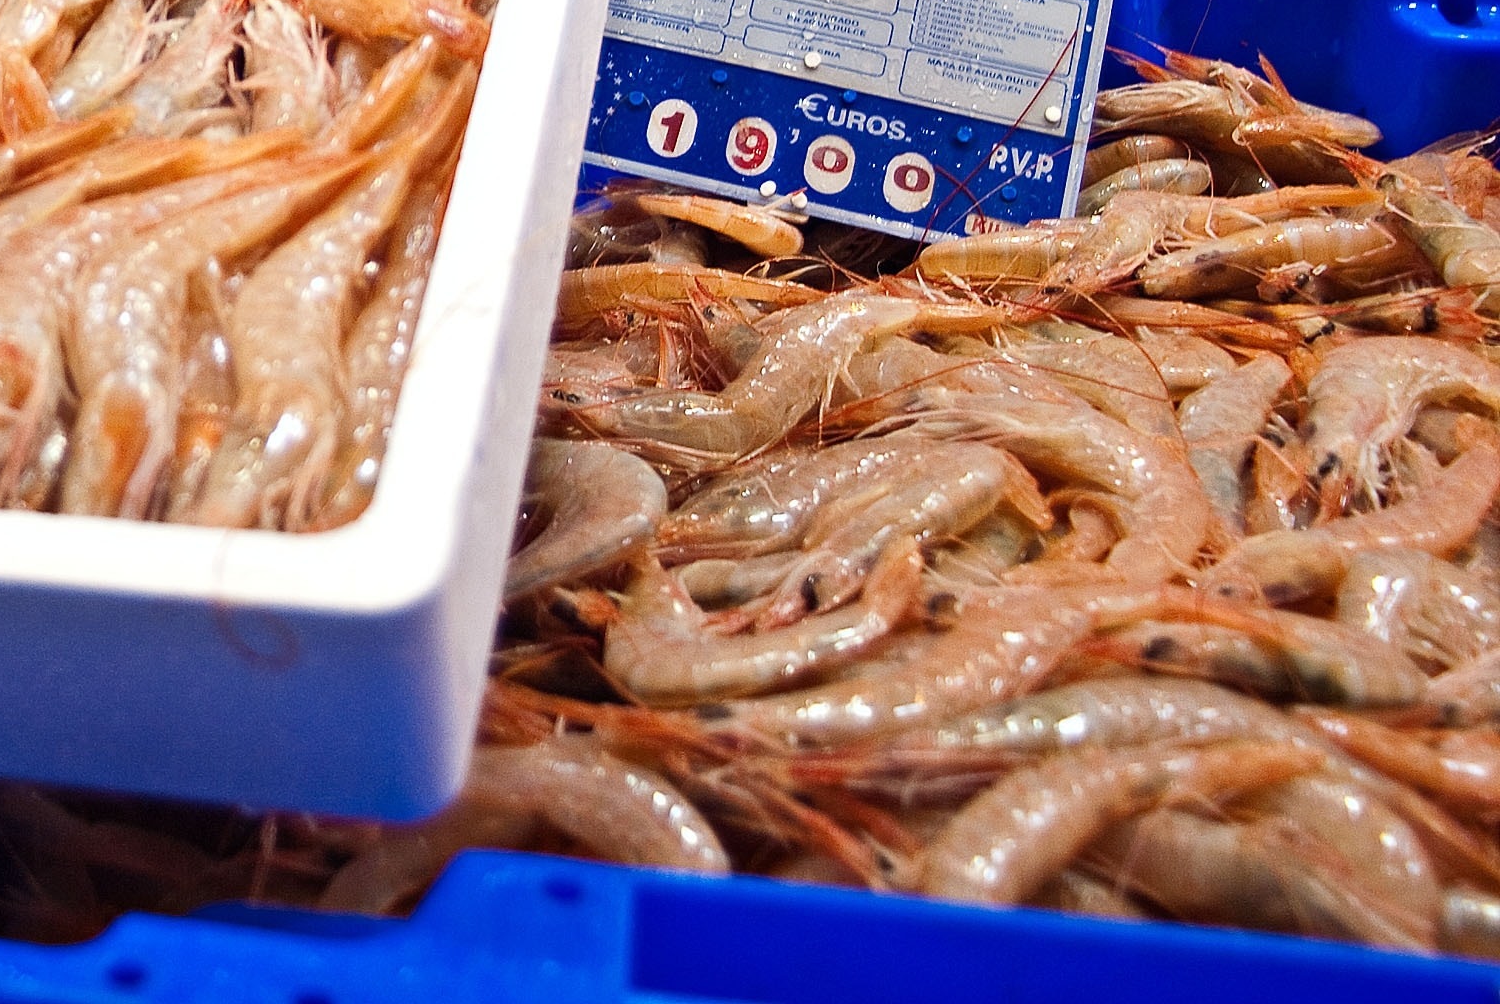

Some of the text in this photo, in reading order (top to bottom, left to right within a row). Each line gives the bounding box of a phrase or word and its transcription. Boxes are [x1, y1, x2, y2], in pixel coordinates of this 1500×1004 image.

[797, 8, 860, 26] CAPTURADO
[832, 23, 867, 36] DULCE
[974, 68, 1004, 80] AGUA
[988, 142, 1053, 182] P.V.P.
